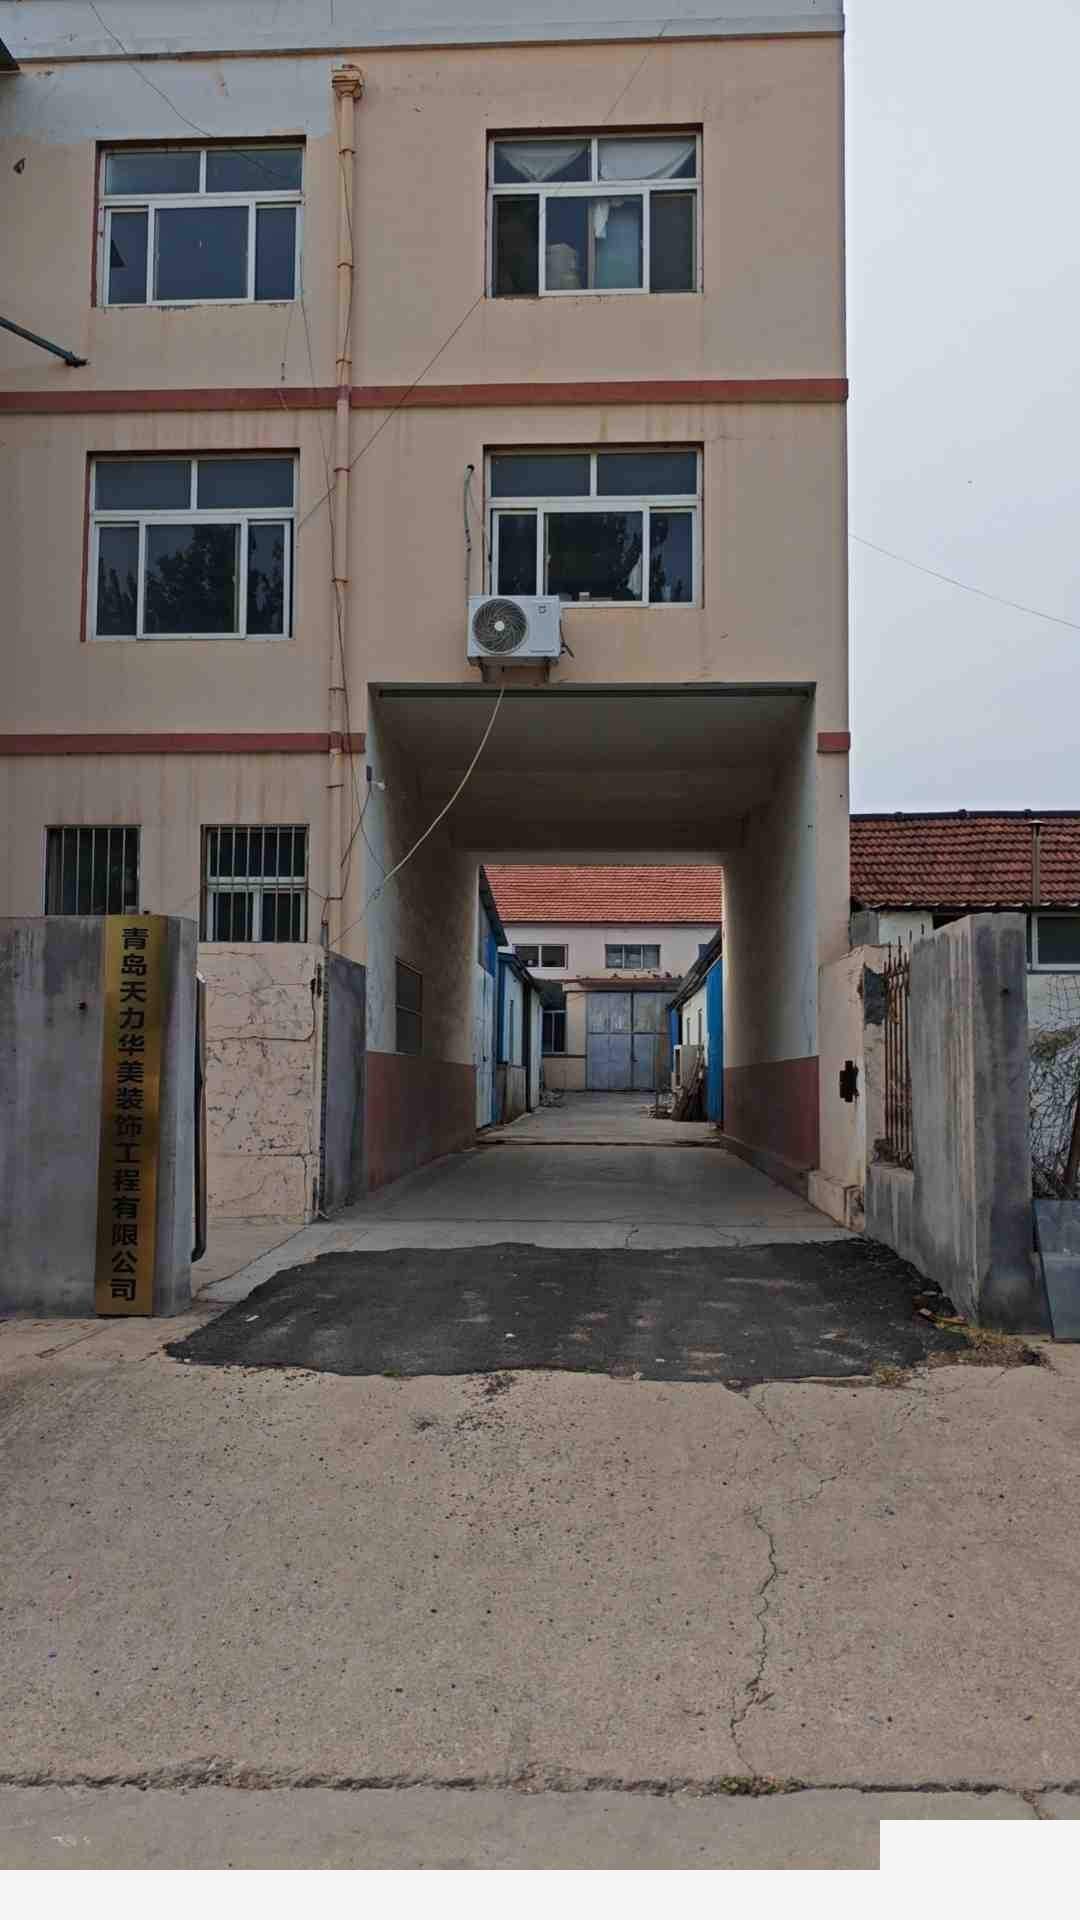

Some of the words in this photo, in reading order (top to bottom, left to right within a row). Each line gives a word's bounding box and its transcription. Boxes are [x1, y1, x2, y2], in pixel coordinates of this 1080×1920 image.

[110, 927, 149, 1302] 青岛天力华美装饰工程有限公司
